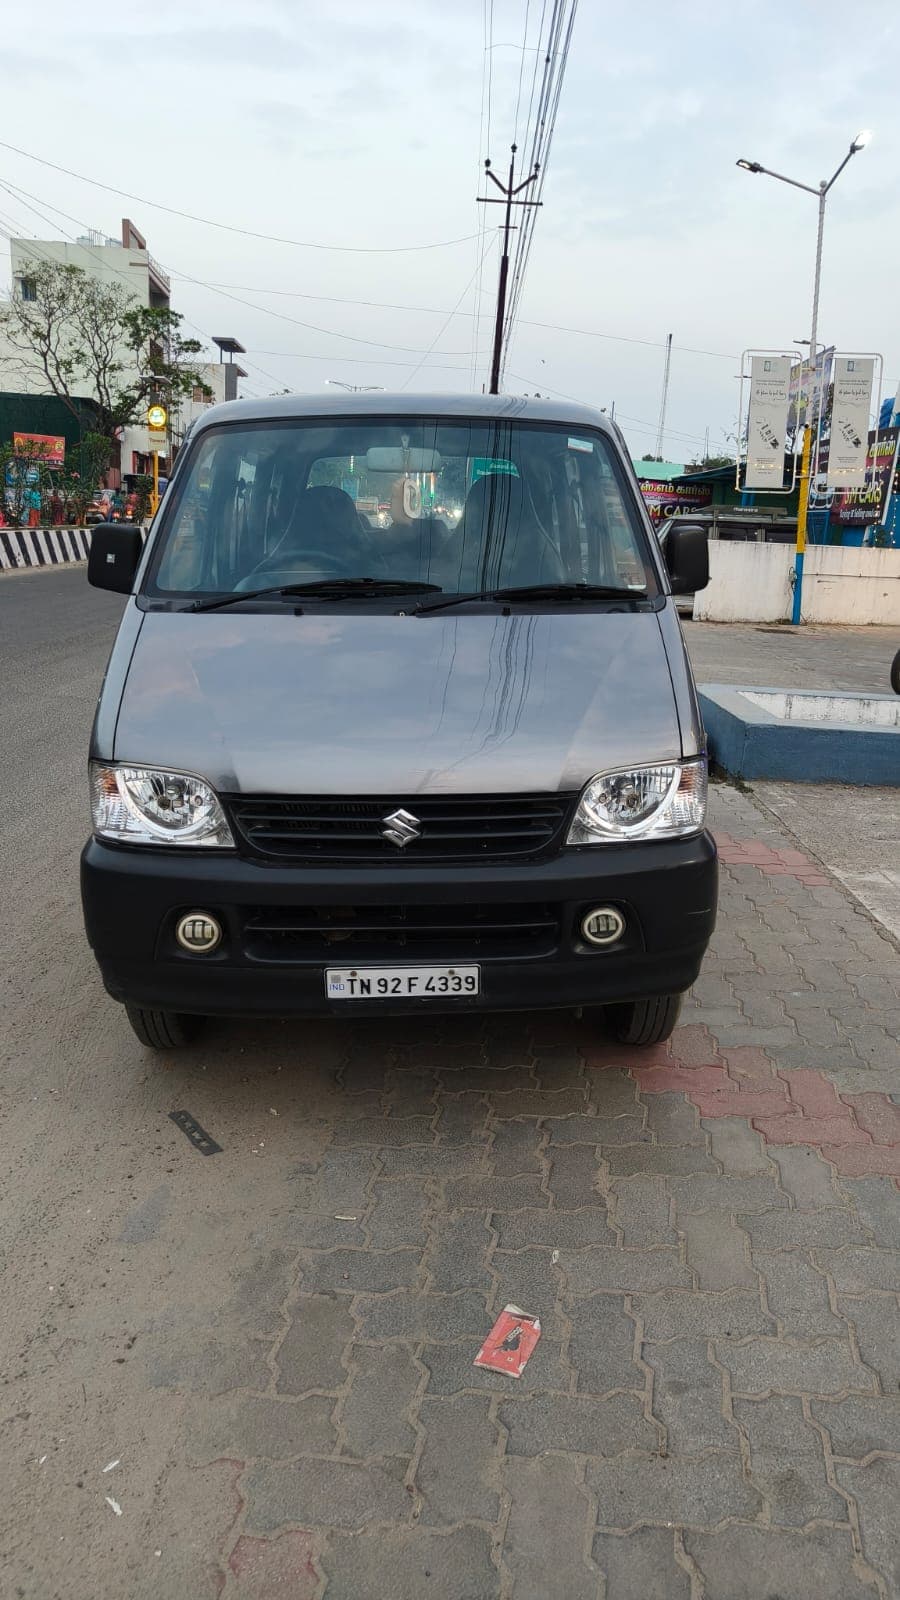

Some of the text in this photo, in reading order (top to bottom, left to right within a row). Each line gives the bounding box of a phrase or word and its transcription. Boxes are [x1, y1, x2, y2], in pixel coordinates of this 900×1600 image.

[346, 975, 476, 995] TN 92 F 4339
